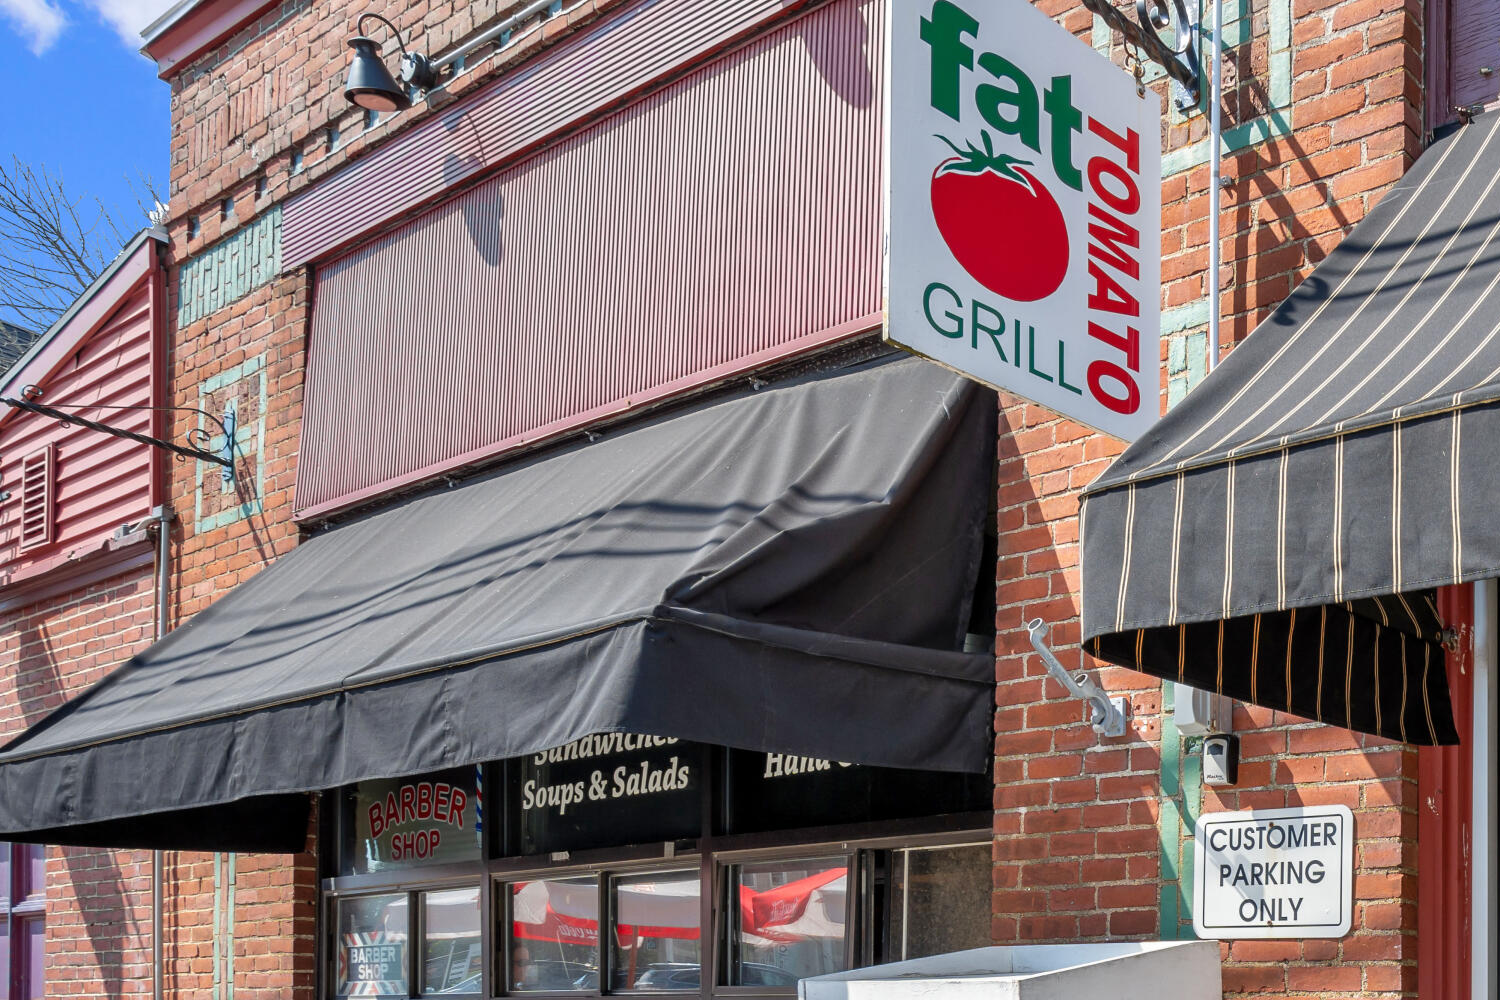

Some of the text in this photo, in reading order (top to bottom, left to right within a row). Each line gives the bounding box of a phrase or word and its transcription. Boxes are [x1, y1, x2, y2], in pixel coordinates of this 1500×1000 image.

[920, 0, 1083, 192] fat
[1087, 115, 1140, 415] TOMATO
[923, 282, 1082, 395] GRILL
[523, 756, 689, 815] Soups & Salads
[368, 782, 466, 839] BARBER
[391, 829, 440, 861] SHOP
[1210, 822, 1337, 851] CUSTOMER
[1220, 860, 1325, 887] PARKING
[1239, 897, 1303, 922] ONLY
[351, 946, 395, 963] BARBER
[358, 964, 388, 980] SHOP
